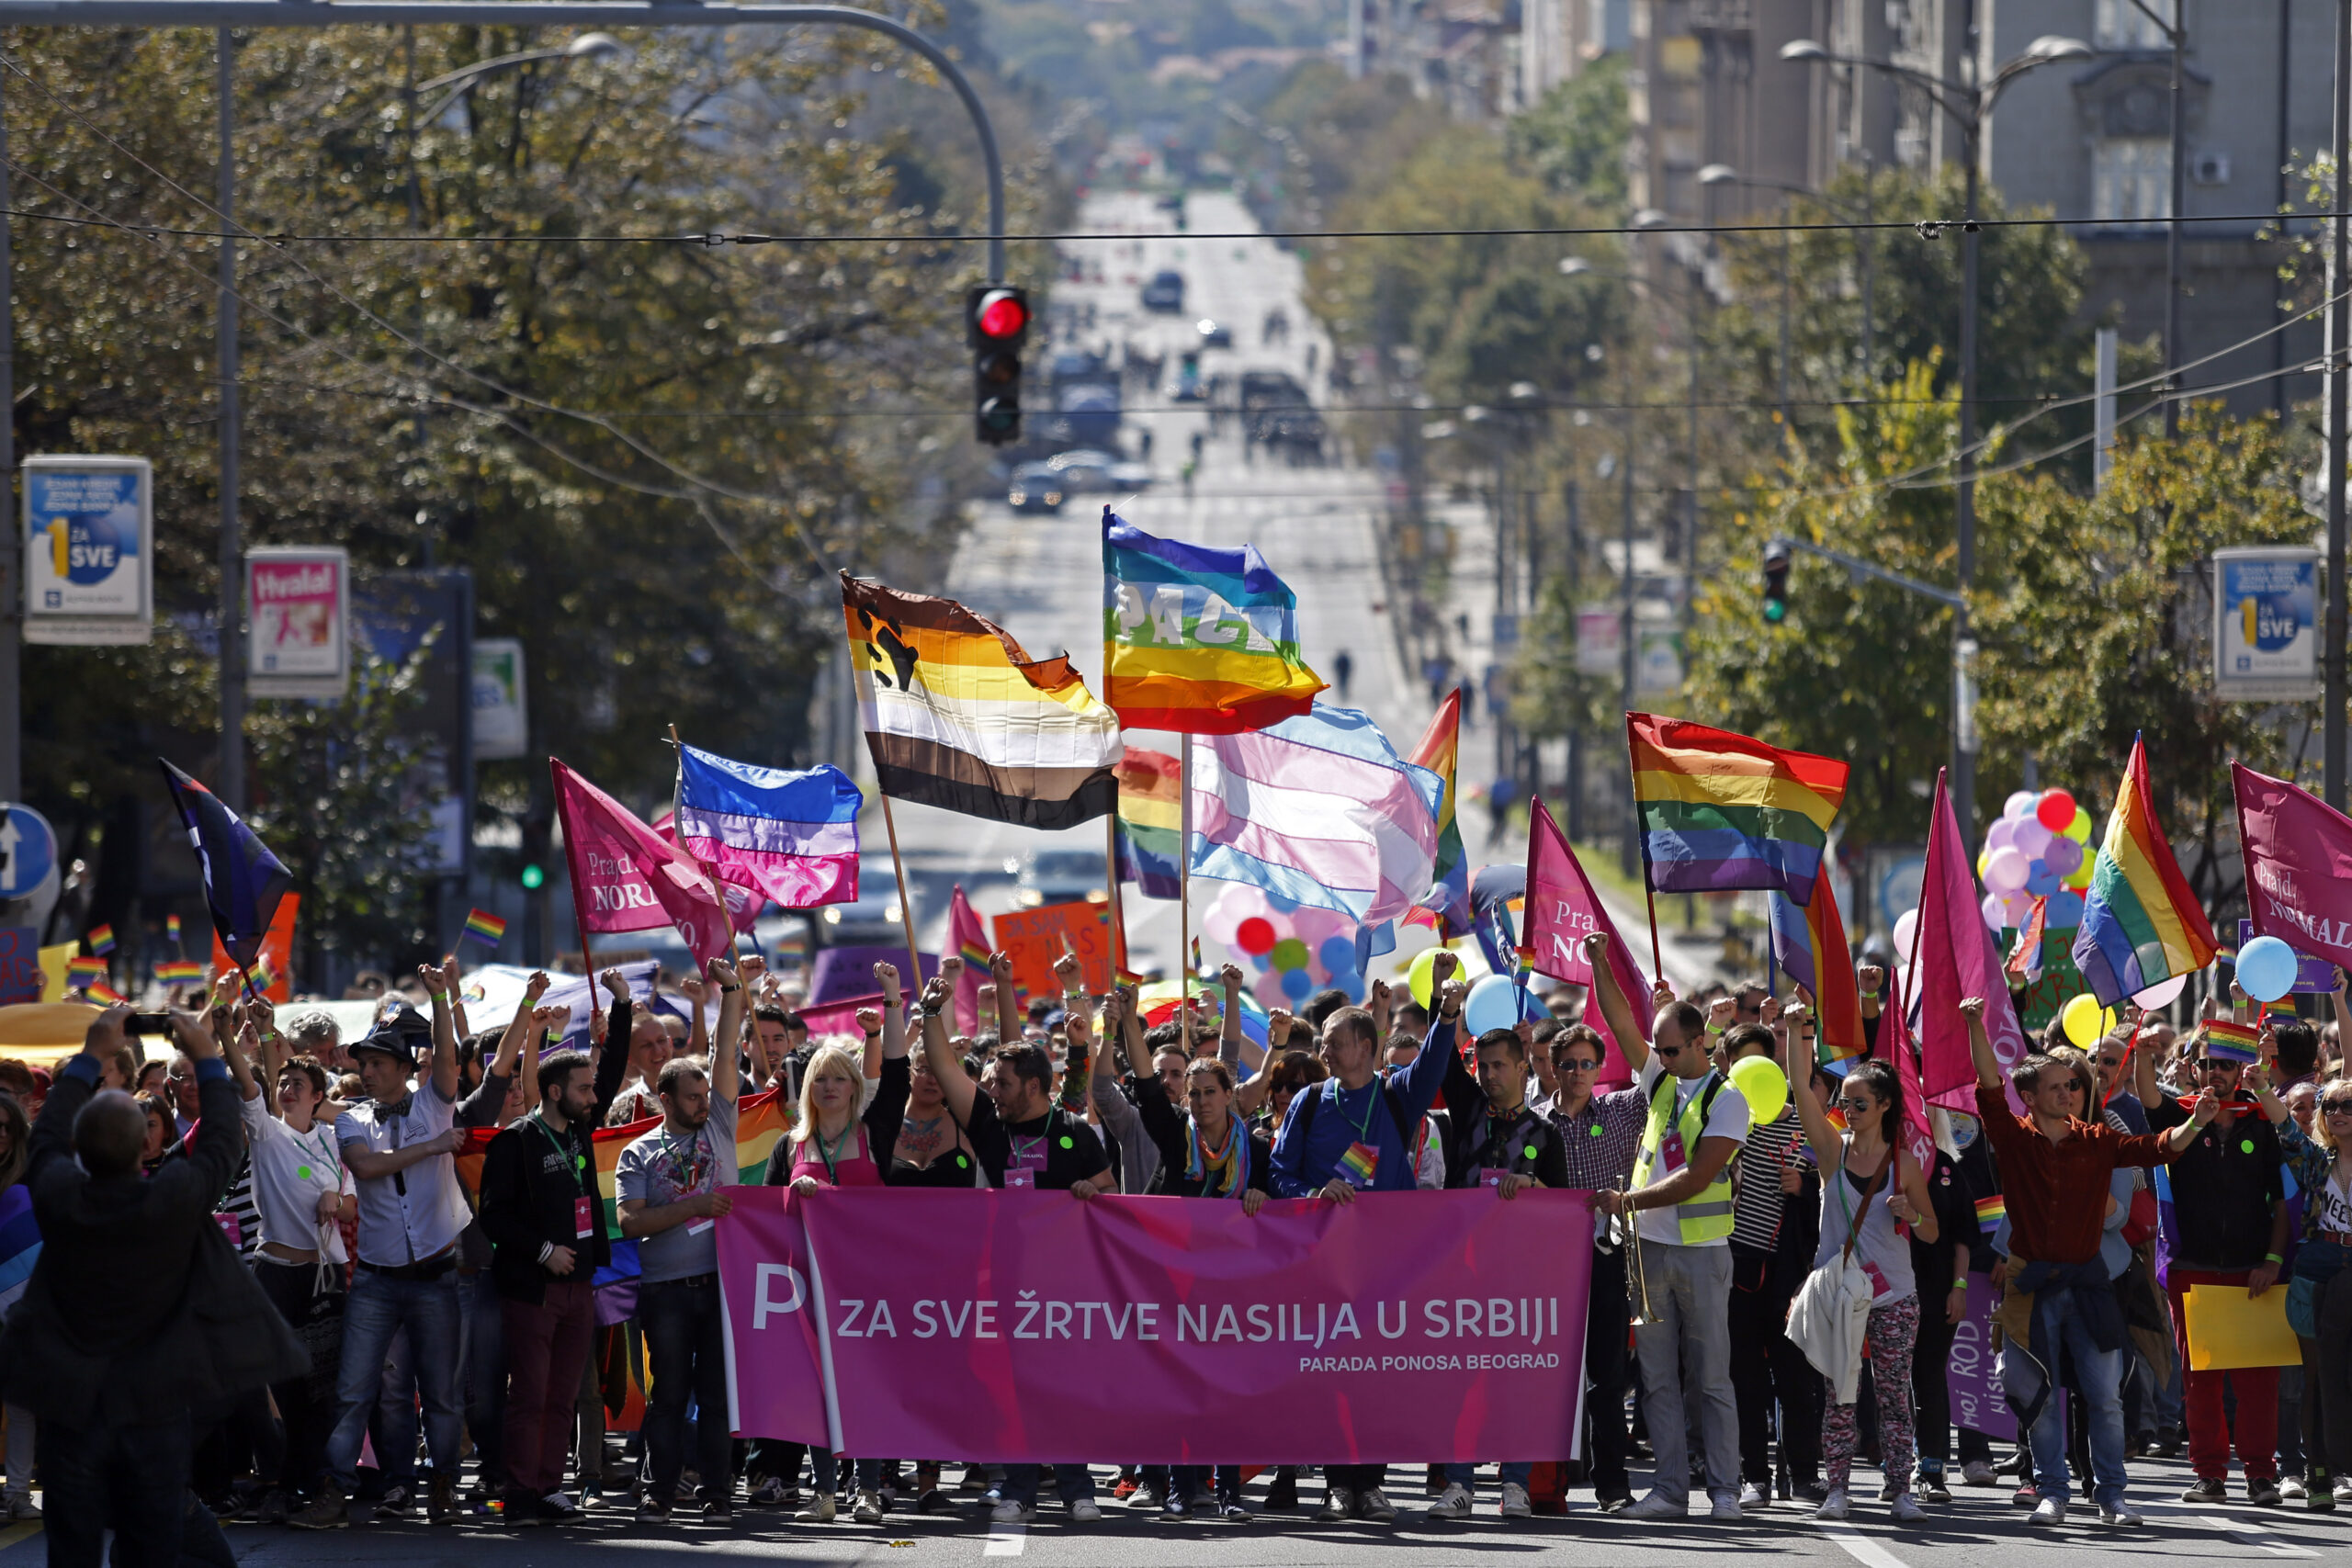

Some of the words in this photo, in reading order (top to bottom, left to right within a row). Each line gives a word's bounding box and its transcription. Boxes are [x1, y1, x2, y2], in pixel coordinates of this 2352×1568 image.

[47, 517, 69, 578] 1
[71, 544, 116, 569] SVE
[2238, 596, 2257, 648] 1
[2258, 618, 2294, 639] SVE
[837, 1299, 898, 1338] ZA
[912, 1299, 999, 1338] SVE
[1012, 1289, 1159, 1341] ŽRTVE
[1177, 1302, 1362, 1349] NASILJA
[1377, 1300, 1407, 1338] U
[1424, 1297, 1558, 1346] SRBIJI
[1299, 1357, 1377, 1372] PARADA
[1382, 1355, 1462, 1371] PONOSA
[1466, 1353, 1560, 1371] BEOGRAD
[1950, 1320, 1980, 1378] ROD
